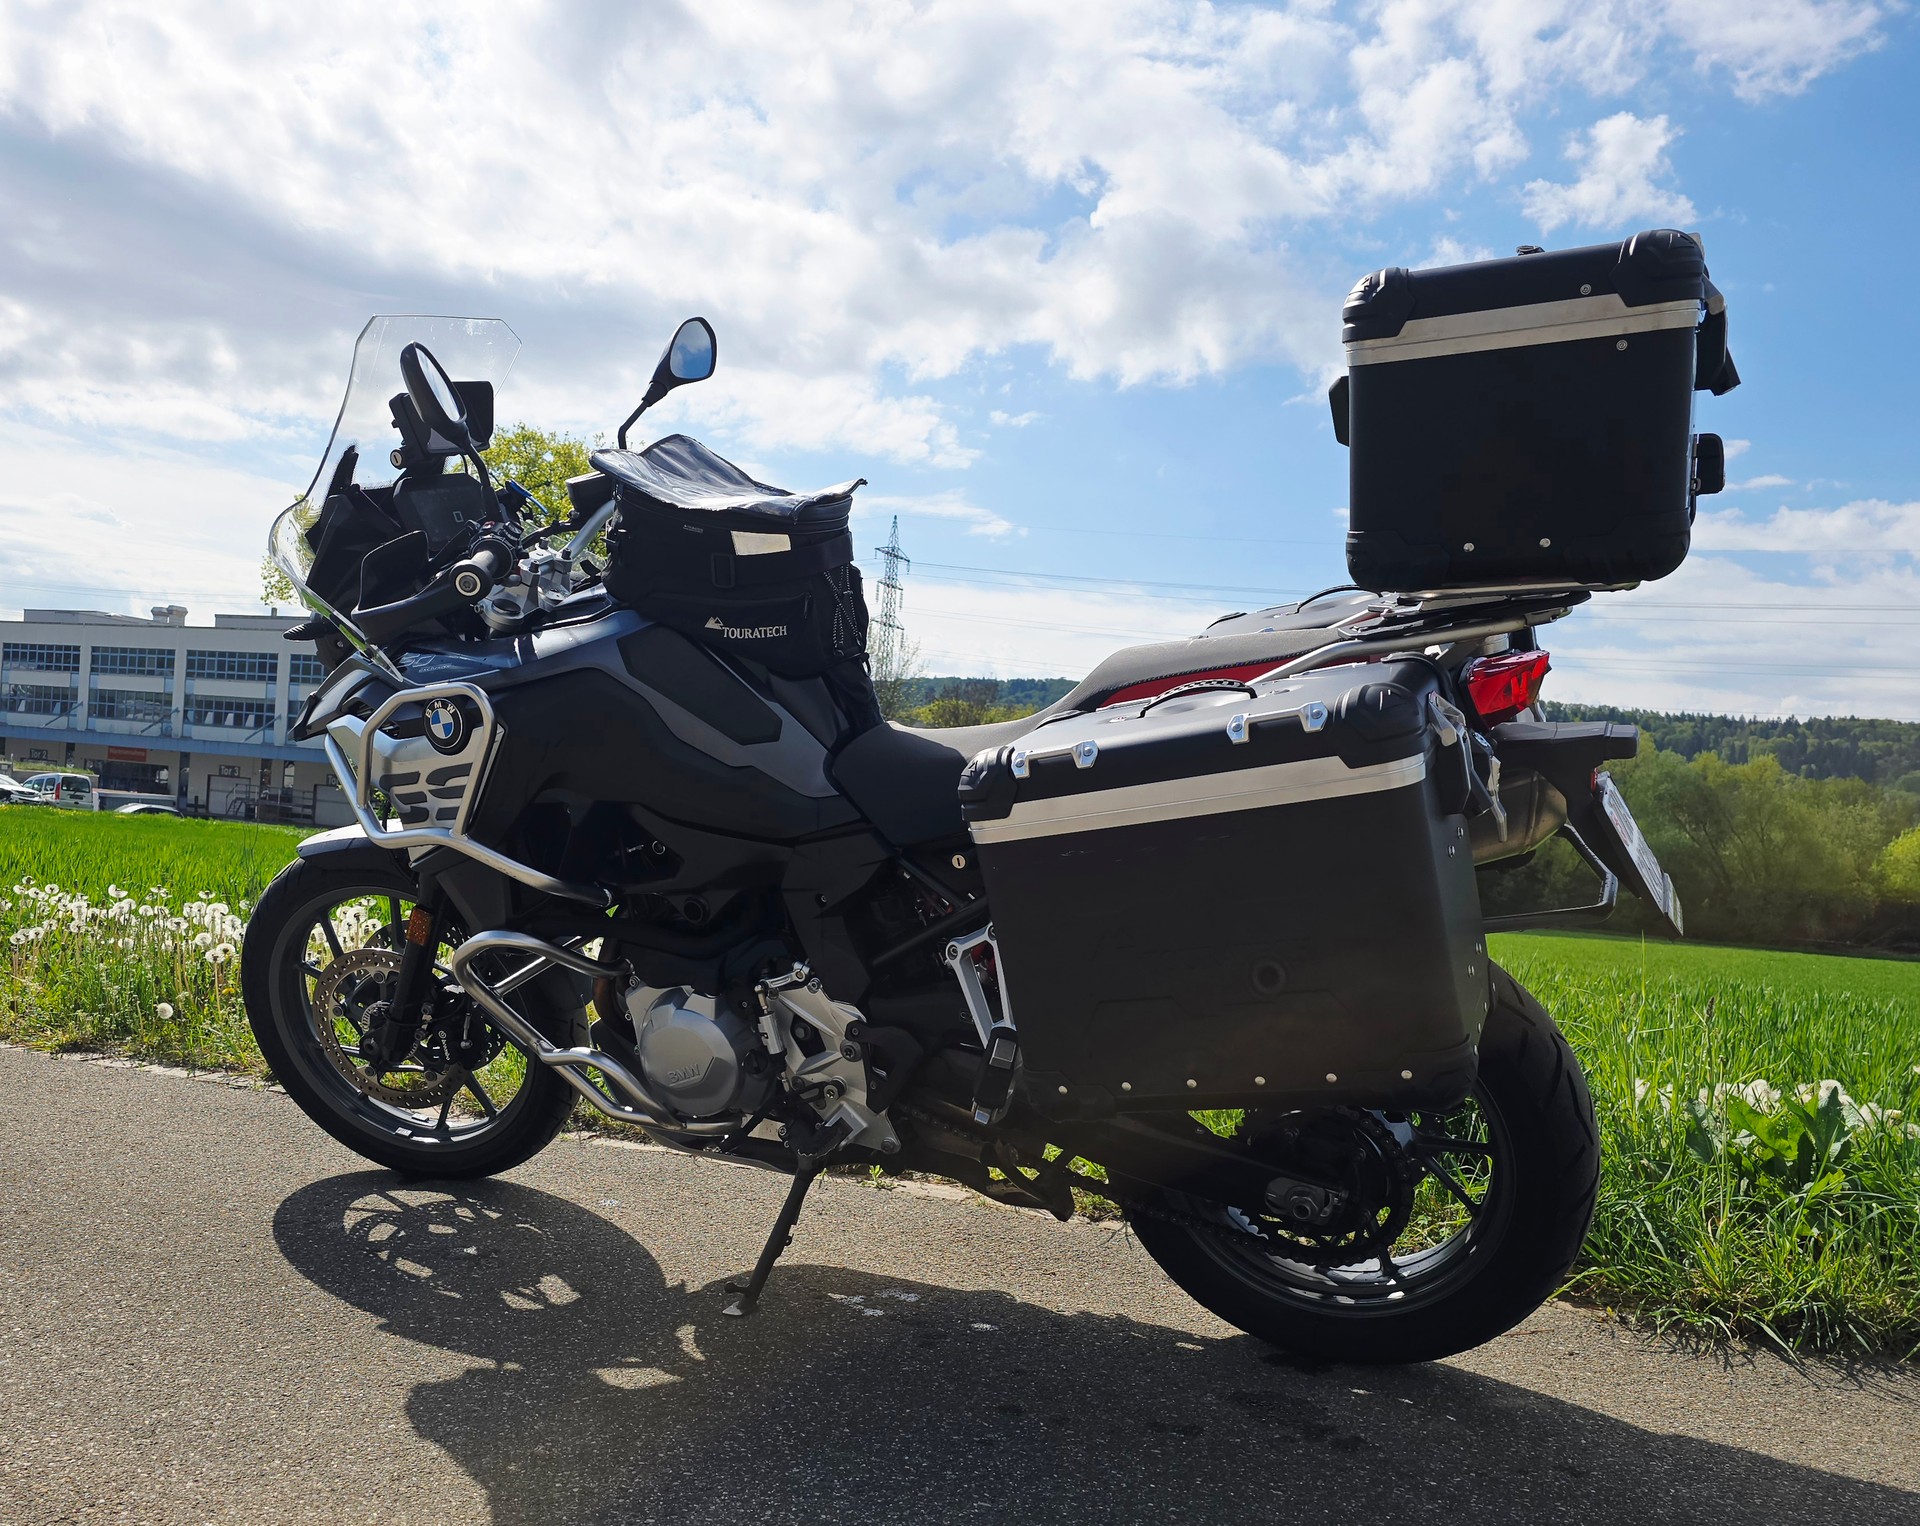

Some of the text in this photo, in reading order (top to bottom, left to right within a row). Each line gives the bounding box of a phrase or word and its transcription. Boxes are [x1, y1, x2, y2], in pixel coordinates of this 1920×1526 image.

[722, 625, 787, 639] TOURATECH
[425, 701, 456, 718] BMW
[31, 749, 47, 759] Tor 2
[221, 766, 239, 777] Tor 3
[668, 1064, 701, 1082] BMW
